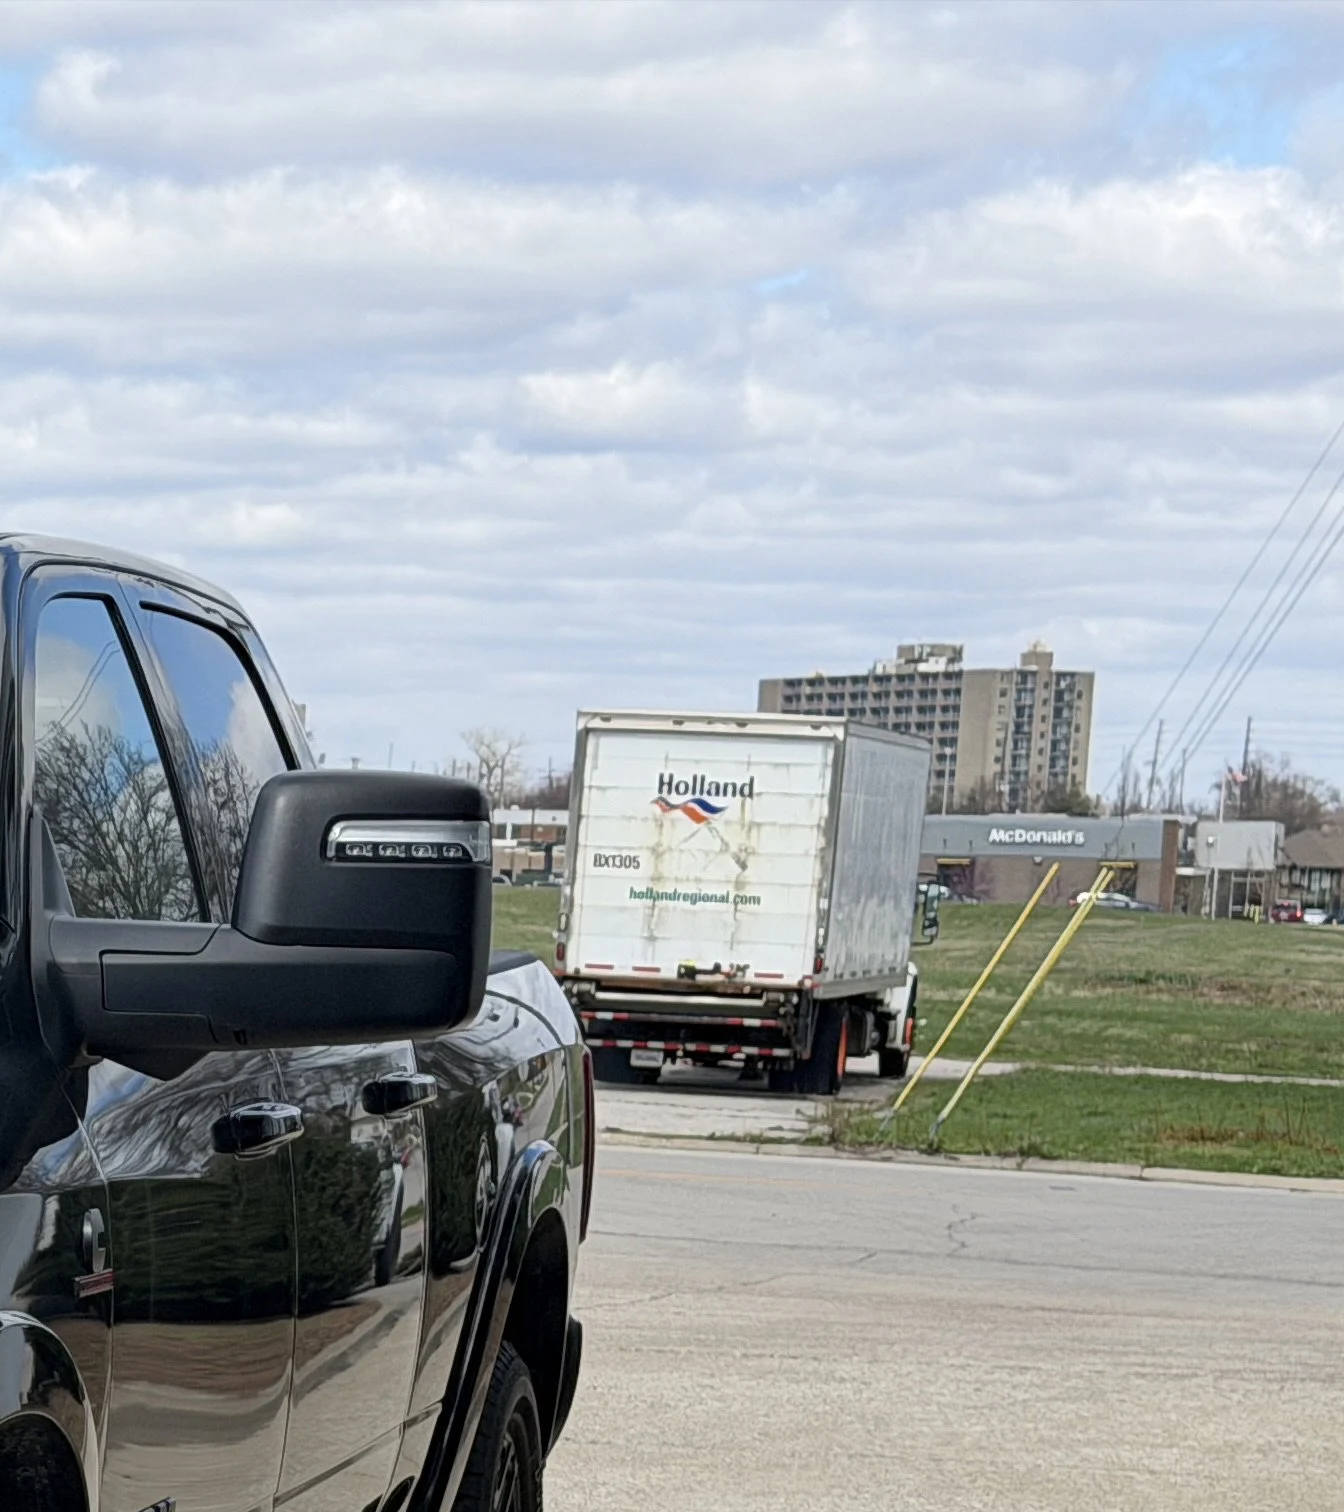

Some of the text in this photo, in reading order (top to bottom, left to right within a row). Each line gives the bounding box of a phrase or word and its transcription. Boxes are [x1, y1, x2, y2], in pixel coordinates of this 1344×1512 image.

[657, 772, 755, 799] Holland
[988, 828, 1085, 845] McDonald's
[628, 886, 762, 906] hollandregional.com
